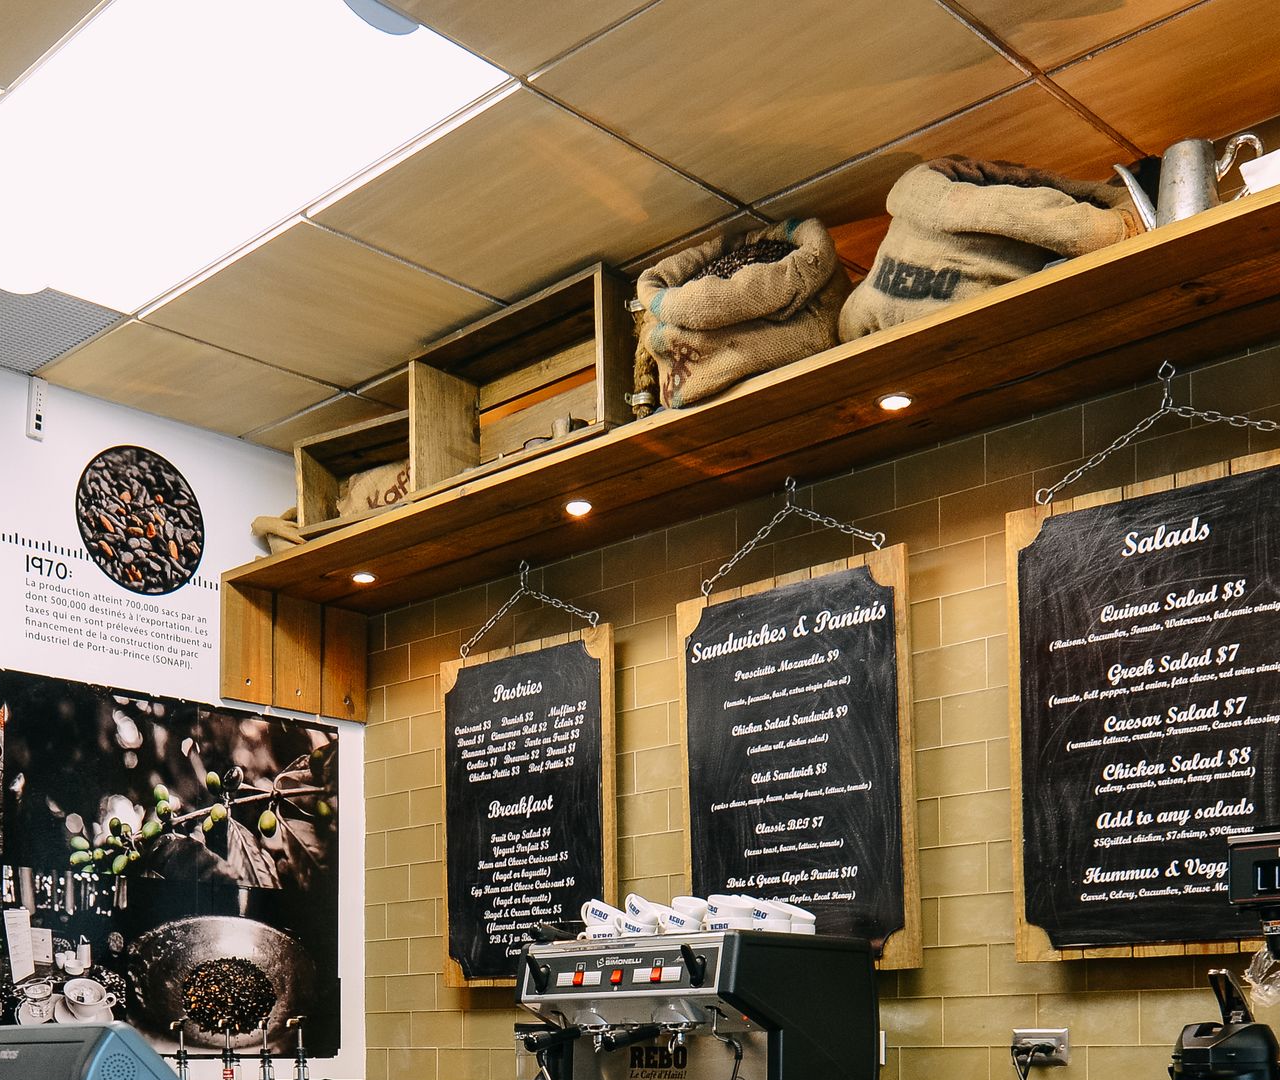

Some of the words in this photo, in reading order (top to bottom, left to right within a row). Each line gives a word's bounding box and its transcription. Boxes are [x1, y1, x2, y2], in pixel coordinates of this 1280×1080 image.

[873, 256, 961, 300] REBO
[1122, 517, 1209, 557] Salads
[26, 554, 72, 580] 1970:
[25, 577, 36, 587] La
[39, 582, 90, 599] production
[93, 594, 122, 606] atteint
[126, 599, 159, 614] 700,000
[161, 608, 179, 618] sacs
[181, 613, 195, 621] par
[197, 616, 207, 624] an
[1100, 602, 1160, 623] Quinoa
[1164, 585, 1218, 610] Salad
[1222, 579, 1246, 601] $8
[691, 624, 786, 663] Sandwiches
[793, 615, 809, 637] &
[814, 601, 886, 633] Paninis
[734, 665, 776, 682] Prosciutto
[777, 653, 825, 672] Mozarella
[827, 649, 839, 663] $9
[1108, 658, 1155, 686] Greek
[1158, 648, 1212, 673] Salad
[1216, 643, 1240, 665] $7
[493, 680, 542, 703] Pastries
[732, 723, 763, 736] Chicken
[764, 715, 790, 730] Salad
[792, 707, 834, 725] Sandwich
[836, 705, 848, 718] $9
[1104, 715, 1162, 732] Caesar
[1166, 700, 1219, 724] Salad
[1223, 696, 1247, 718] $7
[751, 771, 771, 784] Club
[772, 765, 814, 781] Sandwich
[815, 762, 827, 775] $8
[1103, 760, 1166, 780] Chicken
[1170, 750, 1223, 772] Salad
[1227, 747, 1251, 767] $8
[488, 795, 553, 818] Breakfast
[1097, 810, 1133, 829] Add
[1137, 811, 1154, 825] to
[1157, 810, 1191, 826] any
[1194, 798, 1254, 819] salads
[755, 822, 786, 834] Classic
[787, 817, 810, 831] BLT
[812, 816, 824, 828] $7
[1083, 867, 1159, 884] Hummus
[1165, 860, 1180, 877] &
[1184, 858, 1228, 879] Vegg
[630, 1046, 688, 1070] REBO
